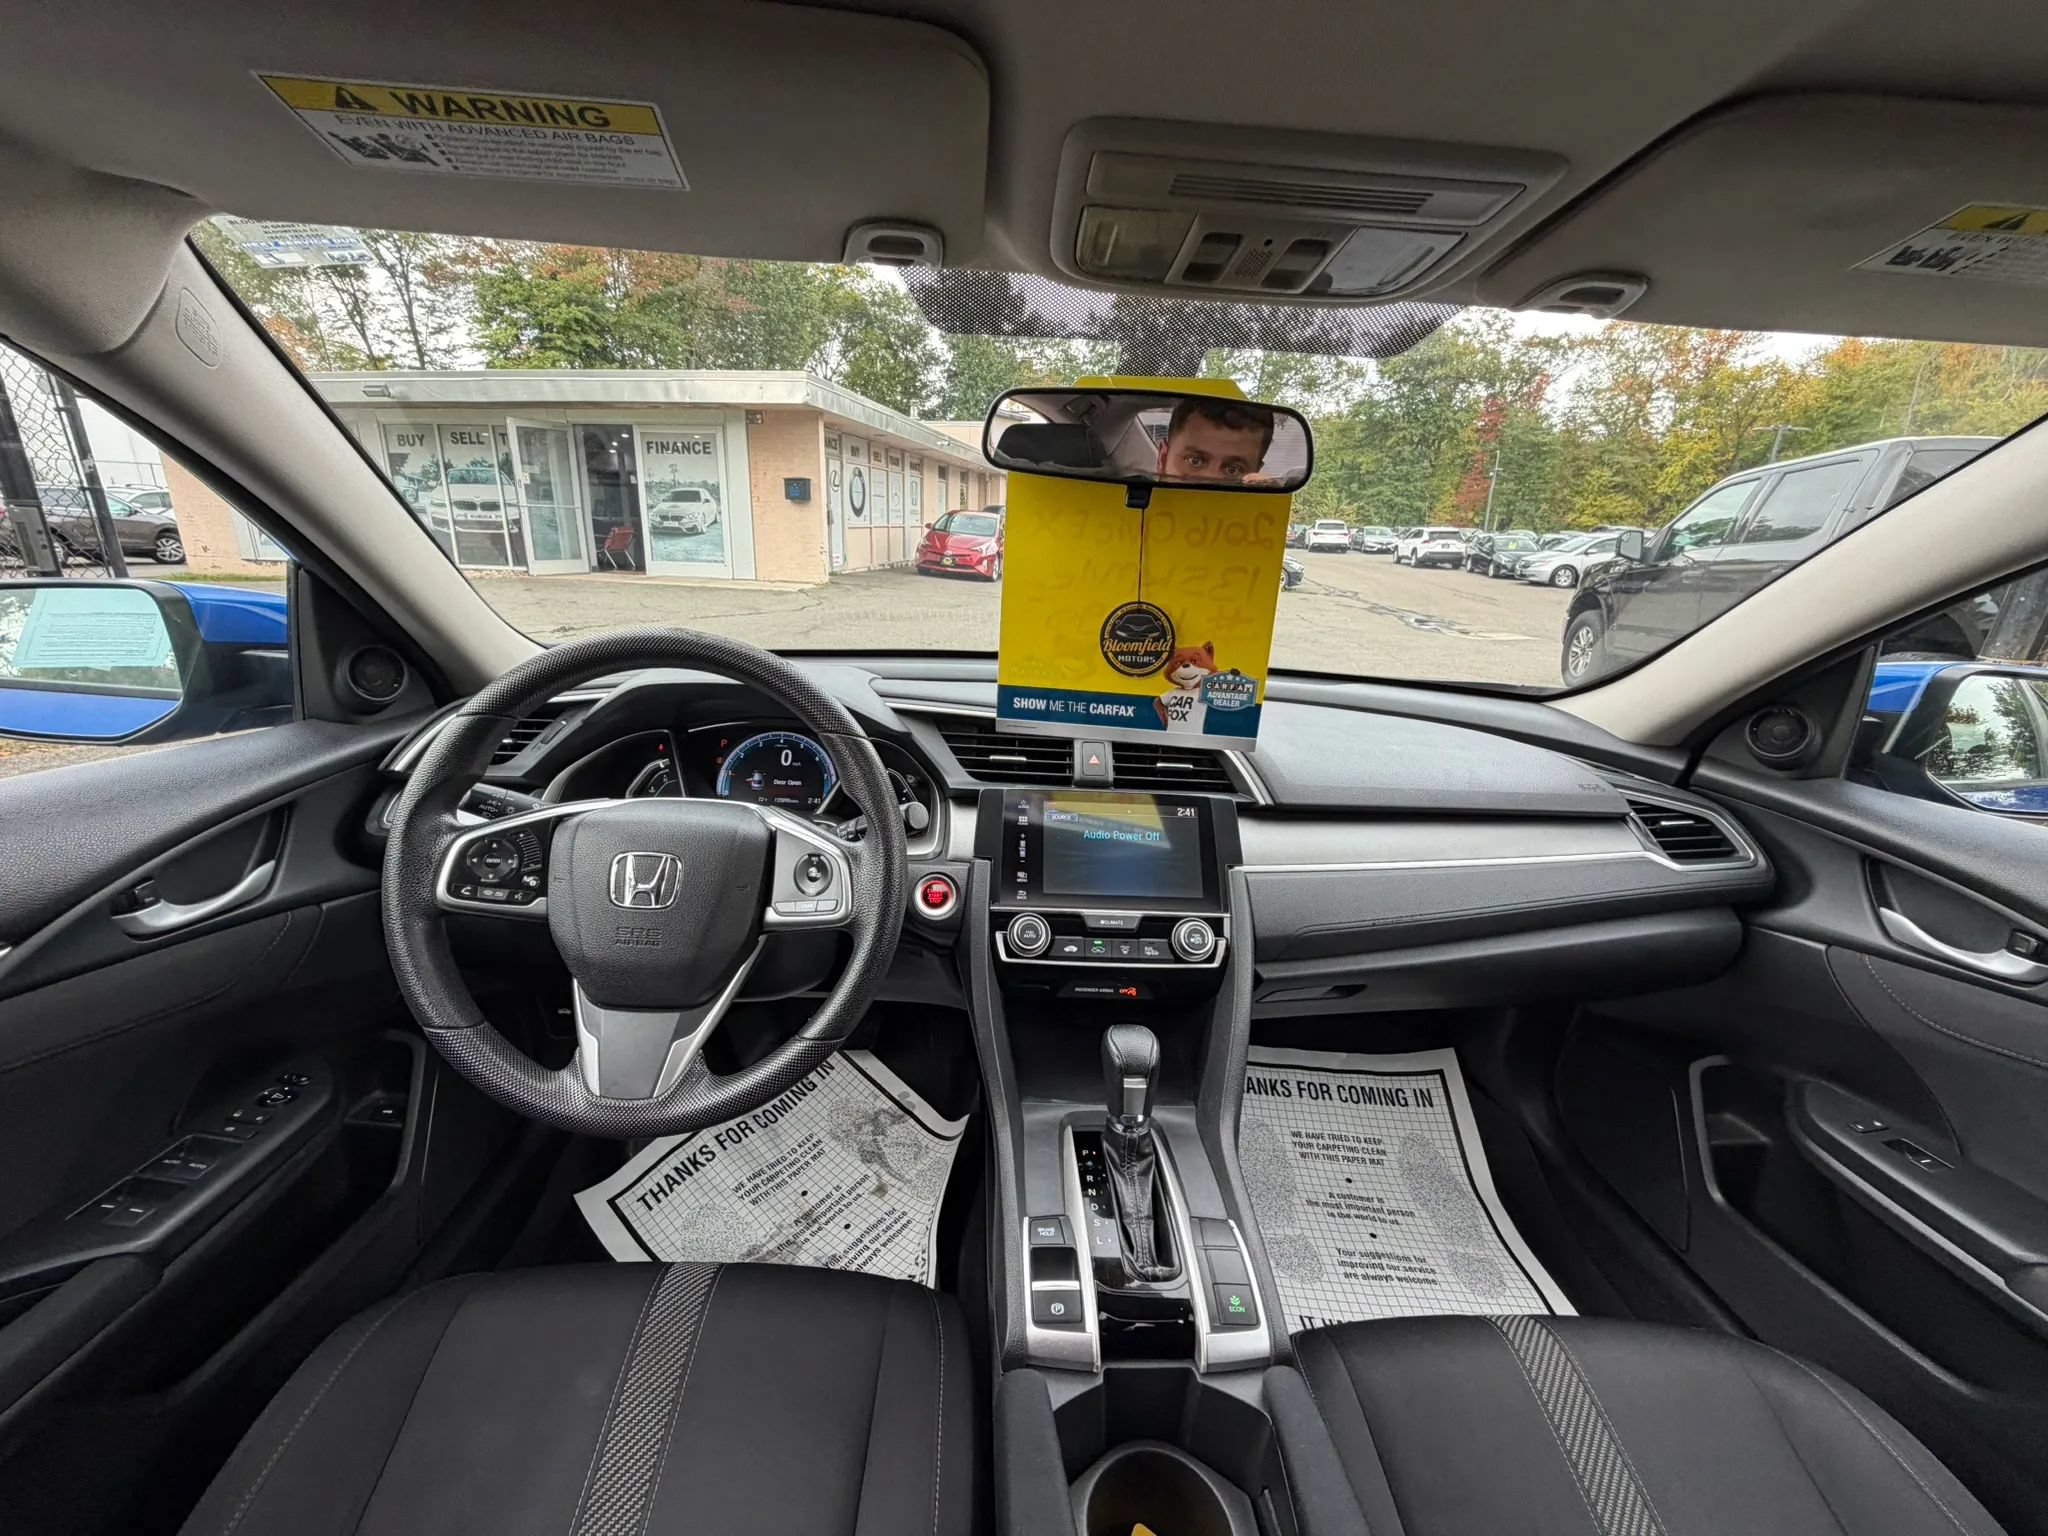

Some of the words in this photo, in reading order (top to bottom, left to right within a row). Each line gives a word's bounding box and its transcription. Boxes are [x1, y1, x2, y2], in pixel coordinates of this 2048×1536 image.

[390, 92, 611, 128] WARNING
[335, 114, 394, 129] EVEN
[396, 116, 442, 132] WITH
[448, 123, 548, 140] ADVANCED
[552, 130, 580, 143] AIR
[585, 132, 635, 146] BAGS
[397, 434, 425, 447] BUY
[450, 432, 485, 447] SELL
[646, 441, 712, 456] FINANCE
[1103, 638, 1173, 655] Bloomfield
[1118, 655, 1156, 663] MOTORS
[1206, 682, 1253, 693] CARFAX
[1169, 696, 1194, 709] CAR
[1207, 691, 1249, 701] ADVANTAGE
[1213, 699, 1240, 708] DEALER
[1013, 697, 1047, 710] SHOW
[1049, 700, 1065, 712] ME
[1067, 701, 1087, 713] THE
[1089, 703, 1135, 717] CARFAX
[781, 749, 792, 766] 0
[1177, 808, 1195, 817] 2:41
[1084, 830, 1111, 840] Audio
[1113, 830, 1142, 841] Power
[1145, 831, 1161, 841] Off
[614, 926, 662, 938] SRS
[613, 938, 662, 946] AIRBAG
[1245, 1076, 1292, 1098] ANKS
[1296, 1080, 1333, 1101] FOR
[1337, 1084, 1409, 1108] COMING
[1413, 1087, 1434, 1109] IN
[636, 1144, 717, 1212] THANKS
[714, 1120, 756, 1151] FOR
[752, 1077, 818, 1128] COMING
[815, 1060, 836, 1081] IN
[1290, 1130, 1303, 1139] WE
[1305, 1132, 1326, 1141] HAVE
[1327, 1133, 1350, 1143] TRIED
[1350, 1135, 1362, 1144] TO
[1363, 1136, 1383, 1146] KEEP
[1292, 1140, 1314, 1150] YOUR
[1316, 1142, 1360, 1154] CARPETING
[1361, 1146, 1387, 1157] CLEAN
[732, 1181, 747, 1193] WE
[745, 1168, 767, 1183] HAVE
[765, 1155, 788, 1171] TRIED
[787, 1147, 798, 1158] TO
[798, 1132, 815, 1149] KEEP
[1299, 1152, 1320, 1161] WITH
[1321, 1153, 1340, 1163] THIS
[1341, 1155, 1367, 1165] PAPER
[1369, 1157, 1386, 1167] MAT
[738, 1183, 762, 1201] YOUR
[761, 1157, 801, 1187] CARPETING
[800, 1138, 823, 1158] CLEAN
[749, 1190, 771, 1206] WITH
[770, 1178, 789, 1193] THIS
[787, 1160, 812, 1180] PAPER
[810, 1148, 826, 1162] MAT
[793, 1218, 802, 1226] A
[800, 1190, 835, 1221] customer
[833, 1184, 843, 1193] is
[1336, 1192, 1374, 1203] customer
[1376, 1196, 1385, 1204] is
[777, 1239, 793, 1252] the
[792, 1222, 812, 1241] most
[811, 1194, 847, 1225] important
[845, 1173, 871, 1196] person
[1091, 1203, 1099, 1211] D
[1306, 1199, 1320, 1207] the
[1322, 1201, 1343, 1210] most
[1344, 1202, 1385, 1216] important
[1386, 1208, 1416, 1218] person
[800, 1236, 810, 1245] in
[809, 1225, 824, 1238] the
[822, 1207, 845, 1227] world
[843, 1200, 853, 1209] to
[1094, 1219, 1100, 1227] S
[1327, 1210, 1337, 1218] in
[1337, 1211, 1351, 1220] the
[1353, 1213, 1378, 1223] world
[1378, 1216, 1388, 1224] to
[843, 1216, 887, 1256] suggestions
[884, 1207, 898, 1219] for
[840, 1244, 870, 1271] proving
[868, 1231, 881, 1245] our
[881, 1210, 908, 1234] service
[1336, 1247, 1357, 1257] Your
[1359, 1250, 1413, 1263] suggestions
[1413, 1255, 1427, 1264] for
[1337, 1259, 1385, 1271] improving
[1386, 1263, 1401, 1272] our
[1402, 1265, 1437, 1275] service
[1343, 1272, 1360, 1280] are
[1360, 1272, 1395, 1283] always
[1229, 1305, 1246, 1313] ECON
